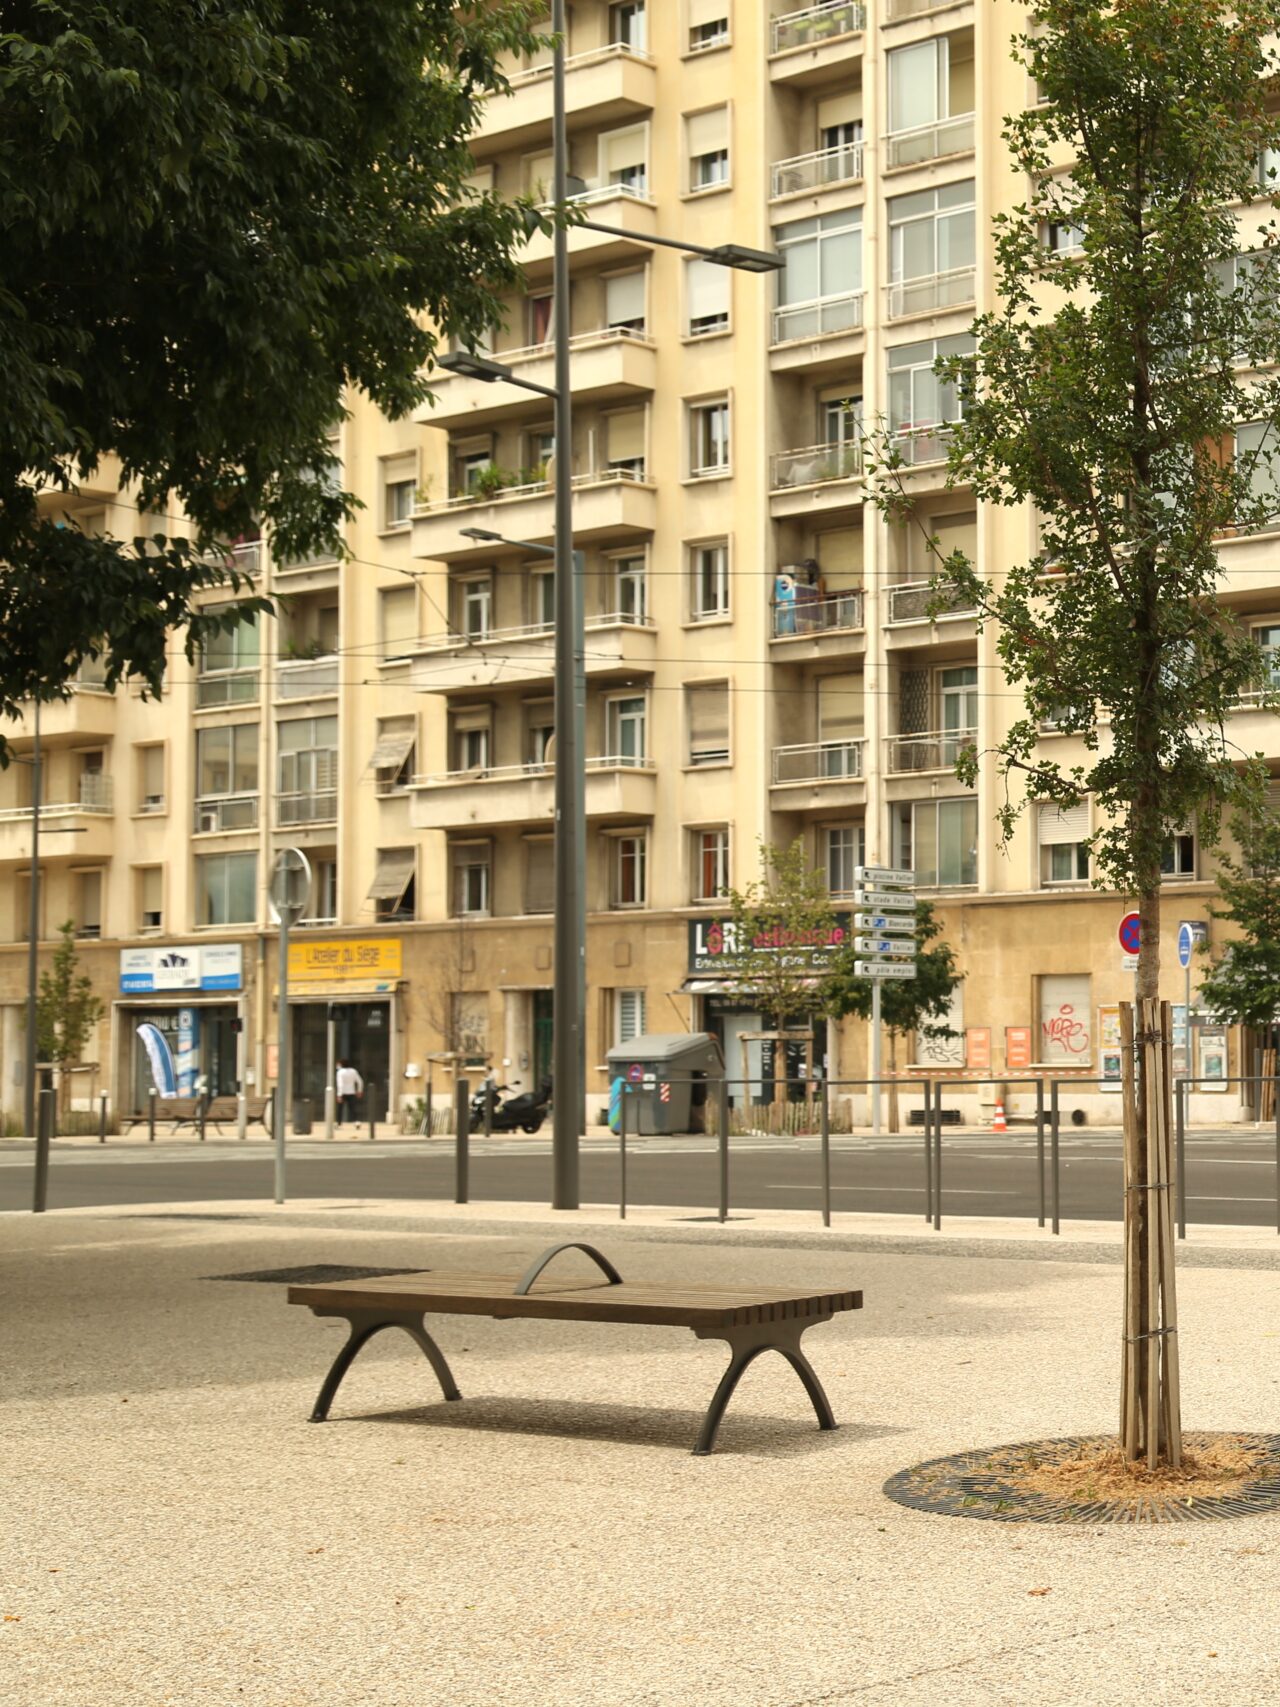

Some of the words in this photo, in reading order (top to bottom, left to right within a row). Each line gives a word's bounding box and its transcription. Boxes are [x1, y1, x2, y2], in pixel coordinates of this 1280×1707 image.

[896, 873, 914, 882] Vallier
[873, 897, 891, 905] stade
[894, 896, 914, 905] Vallier
[893, 943, 914, 952] Vallier
[892, 966, 914, 976] emploi
